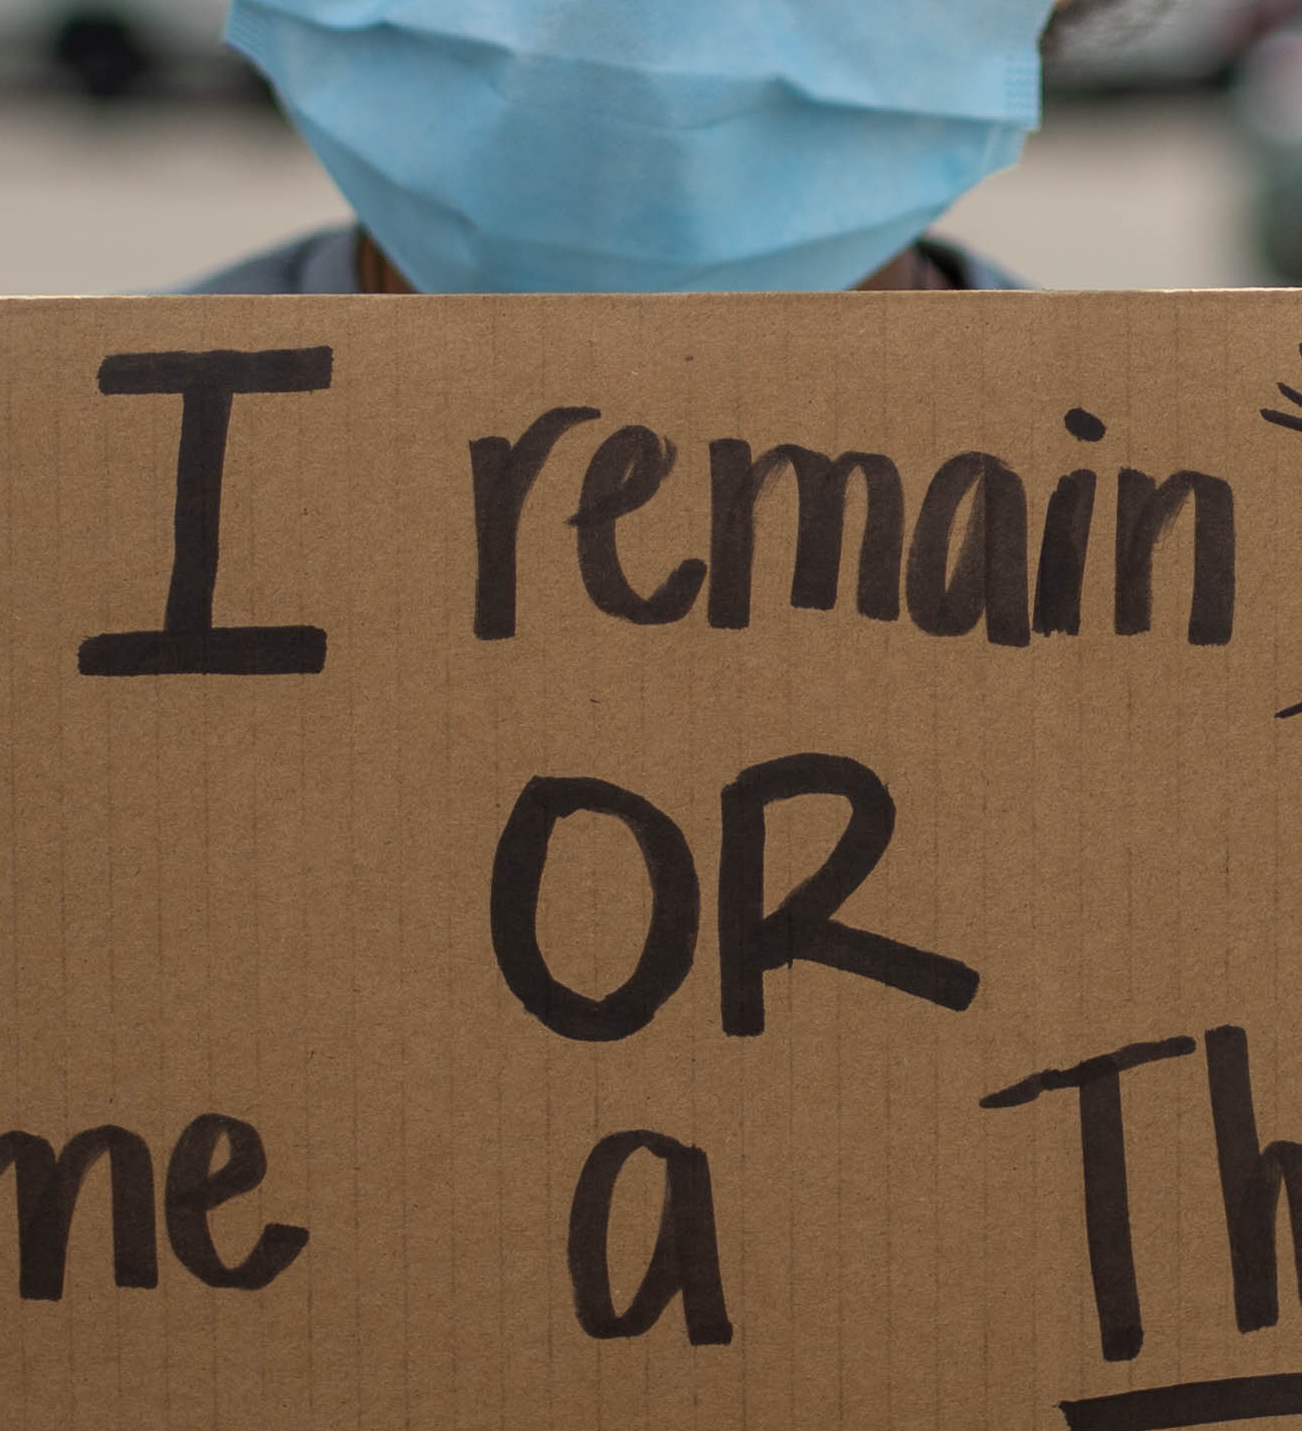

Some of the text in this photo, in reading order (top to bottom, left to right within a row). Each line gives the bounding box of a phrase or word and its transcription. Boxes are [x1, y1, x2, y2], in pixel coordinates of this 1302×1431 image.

[77, 346, 334, 677] I
[469, 406, 1235, 647] remain
[490, 753, 980, 1042] OR
[567, 1129, 733, 1347] a
